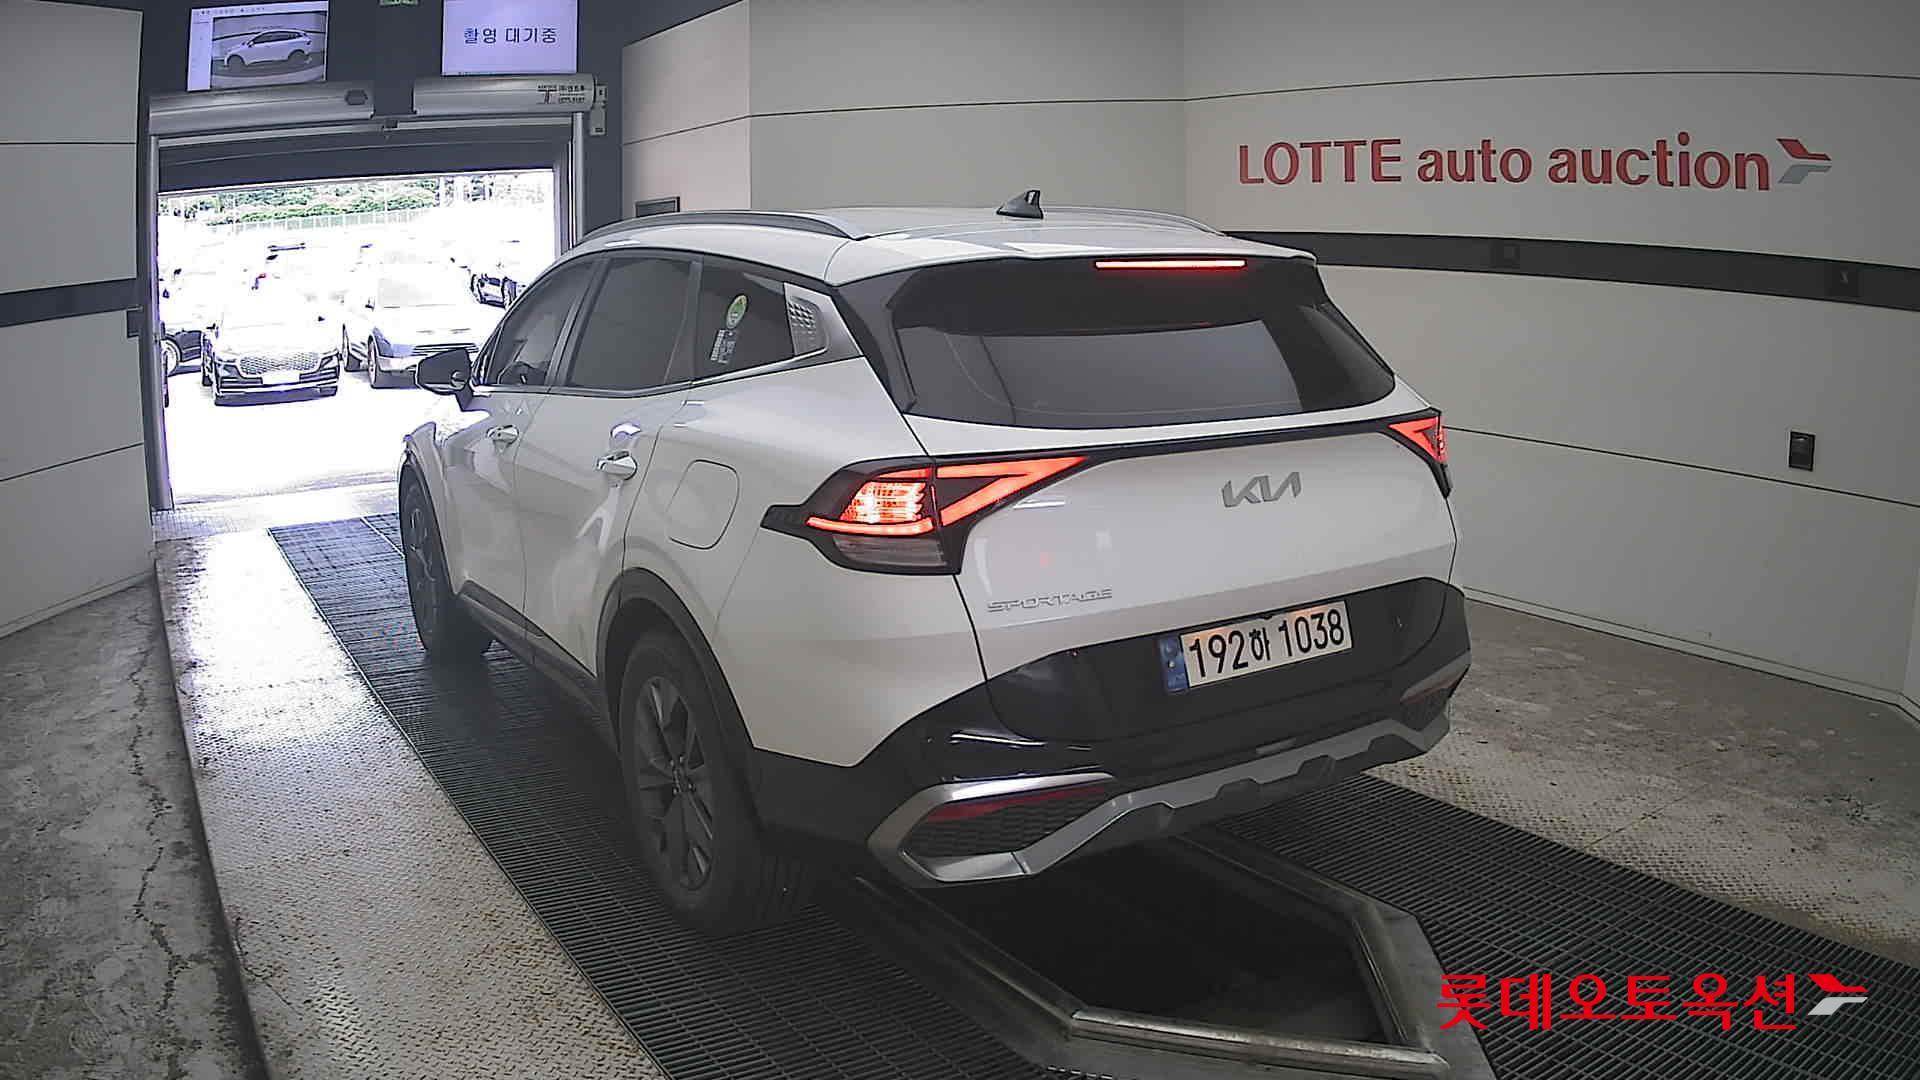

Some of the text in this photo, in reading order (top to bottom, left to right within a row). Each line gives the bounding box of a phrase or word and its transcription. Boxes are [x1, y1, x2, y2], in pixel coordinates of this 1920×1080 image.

[464, 27, 557, 44] 촬영 대기중
[1239, 132, 1770, 190] LOTTE auto auction
[1221, 471, 1302, 508] KIA
[988, 588, 1113, 613] SPORTAGE
[1189, 608, 1345, 678] 192하 1038
